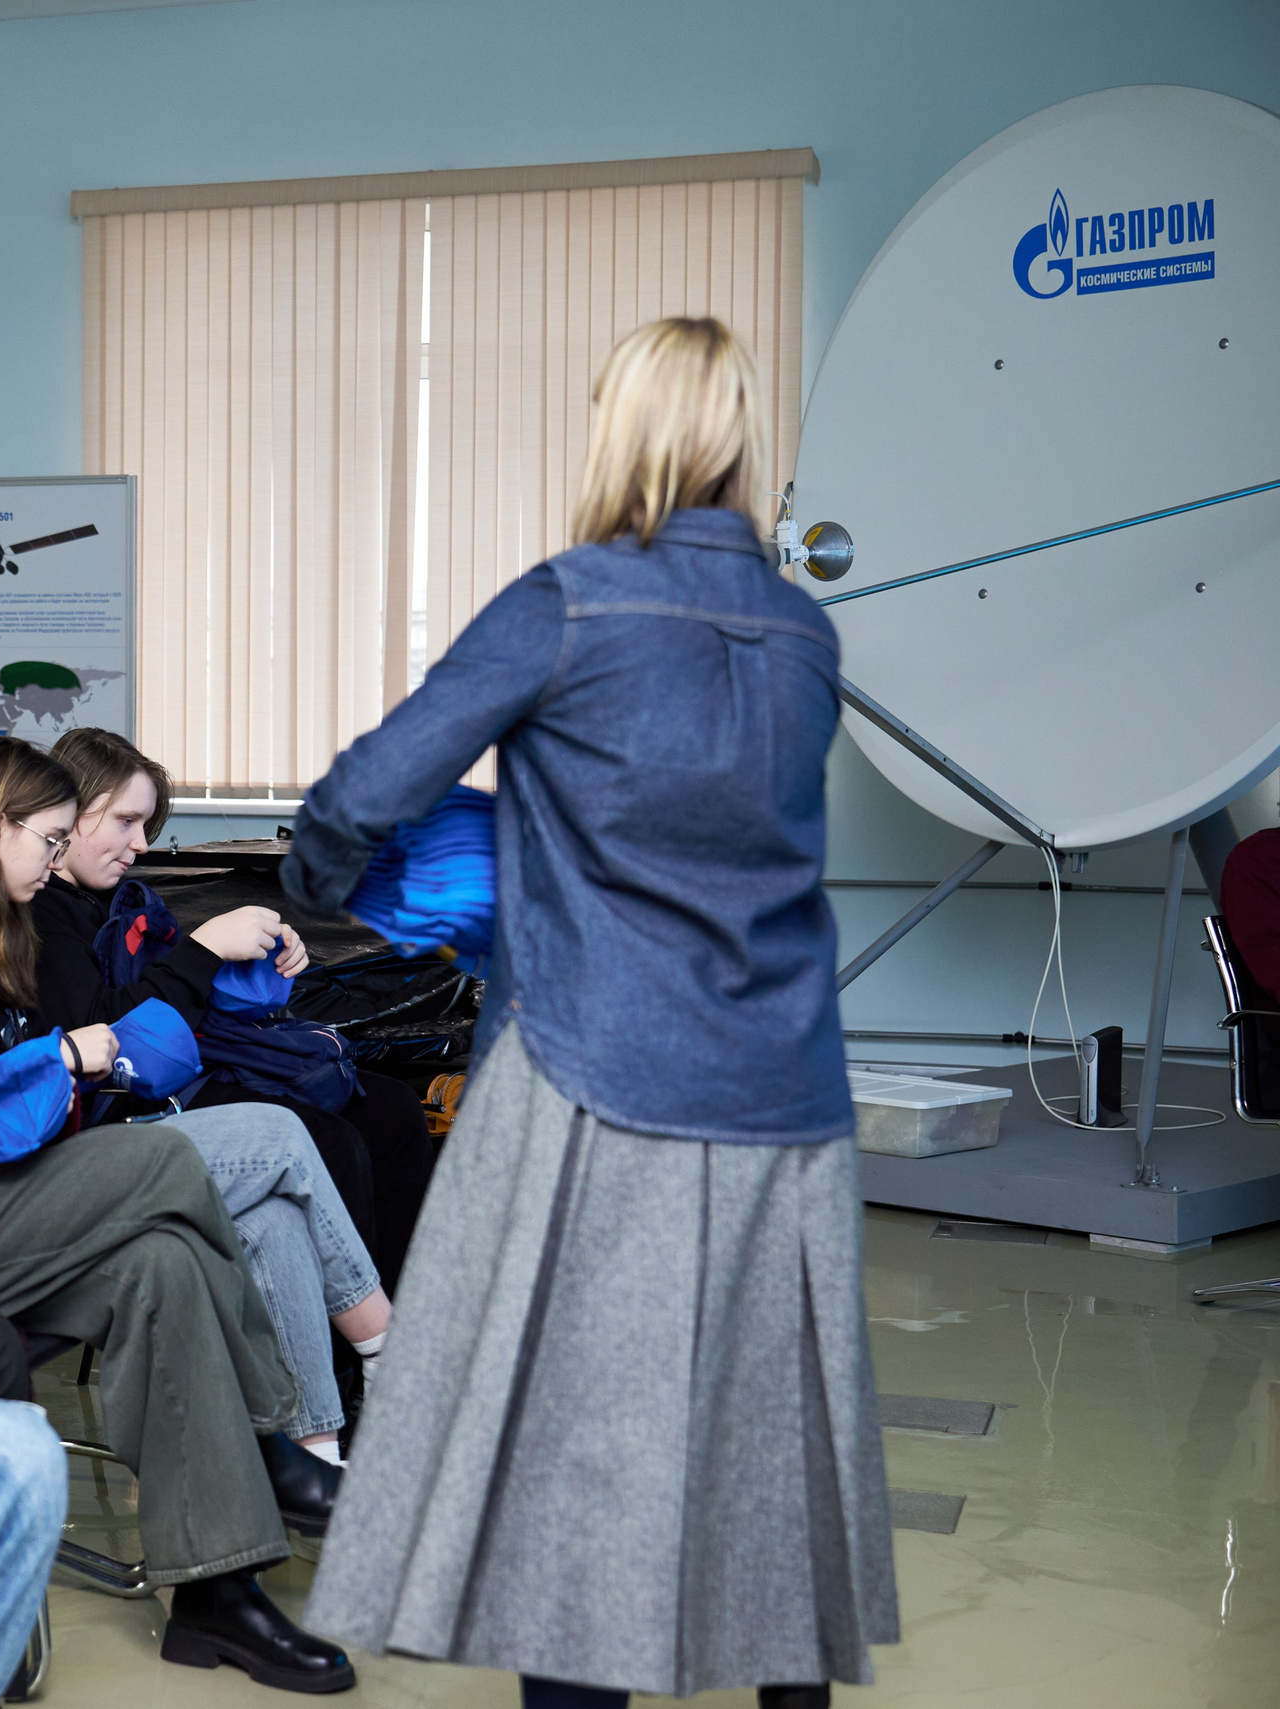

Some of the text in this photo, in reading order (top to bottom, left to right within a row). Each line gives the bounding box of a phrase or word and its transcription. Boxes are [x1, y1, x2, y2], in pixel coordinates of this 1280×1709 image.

[1075, 198, 1215, 258] ГАЗПРОМ
[1079, 259, 1212, 288] КОСМИЧЕСКИЕ СИСТЕМЫ
